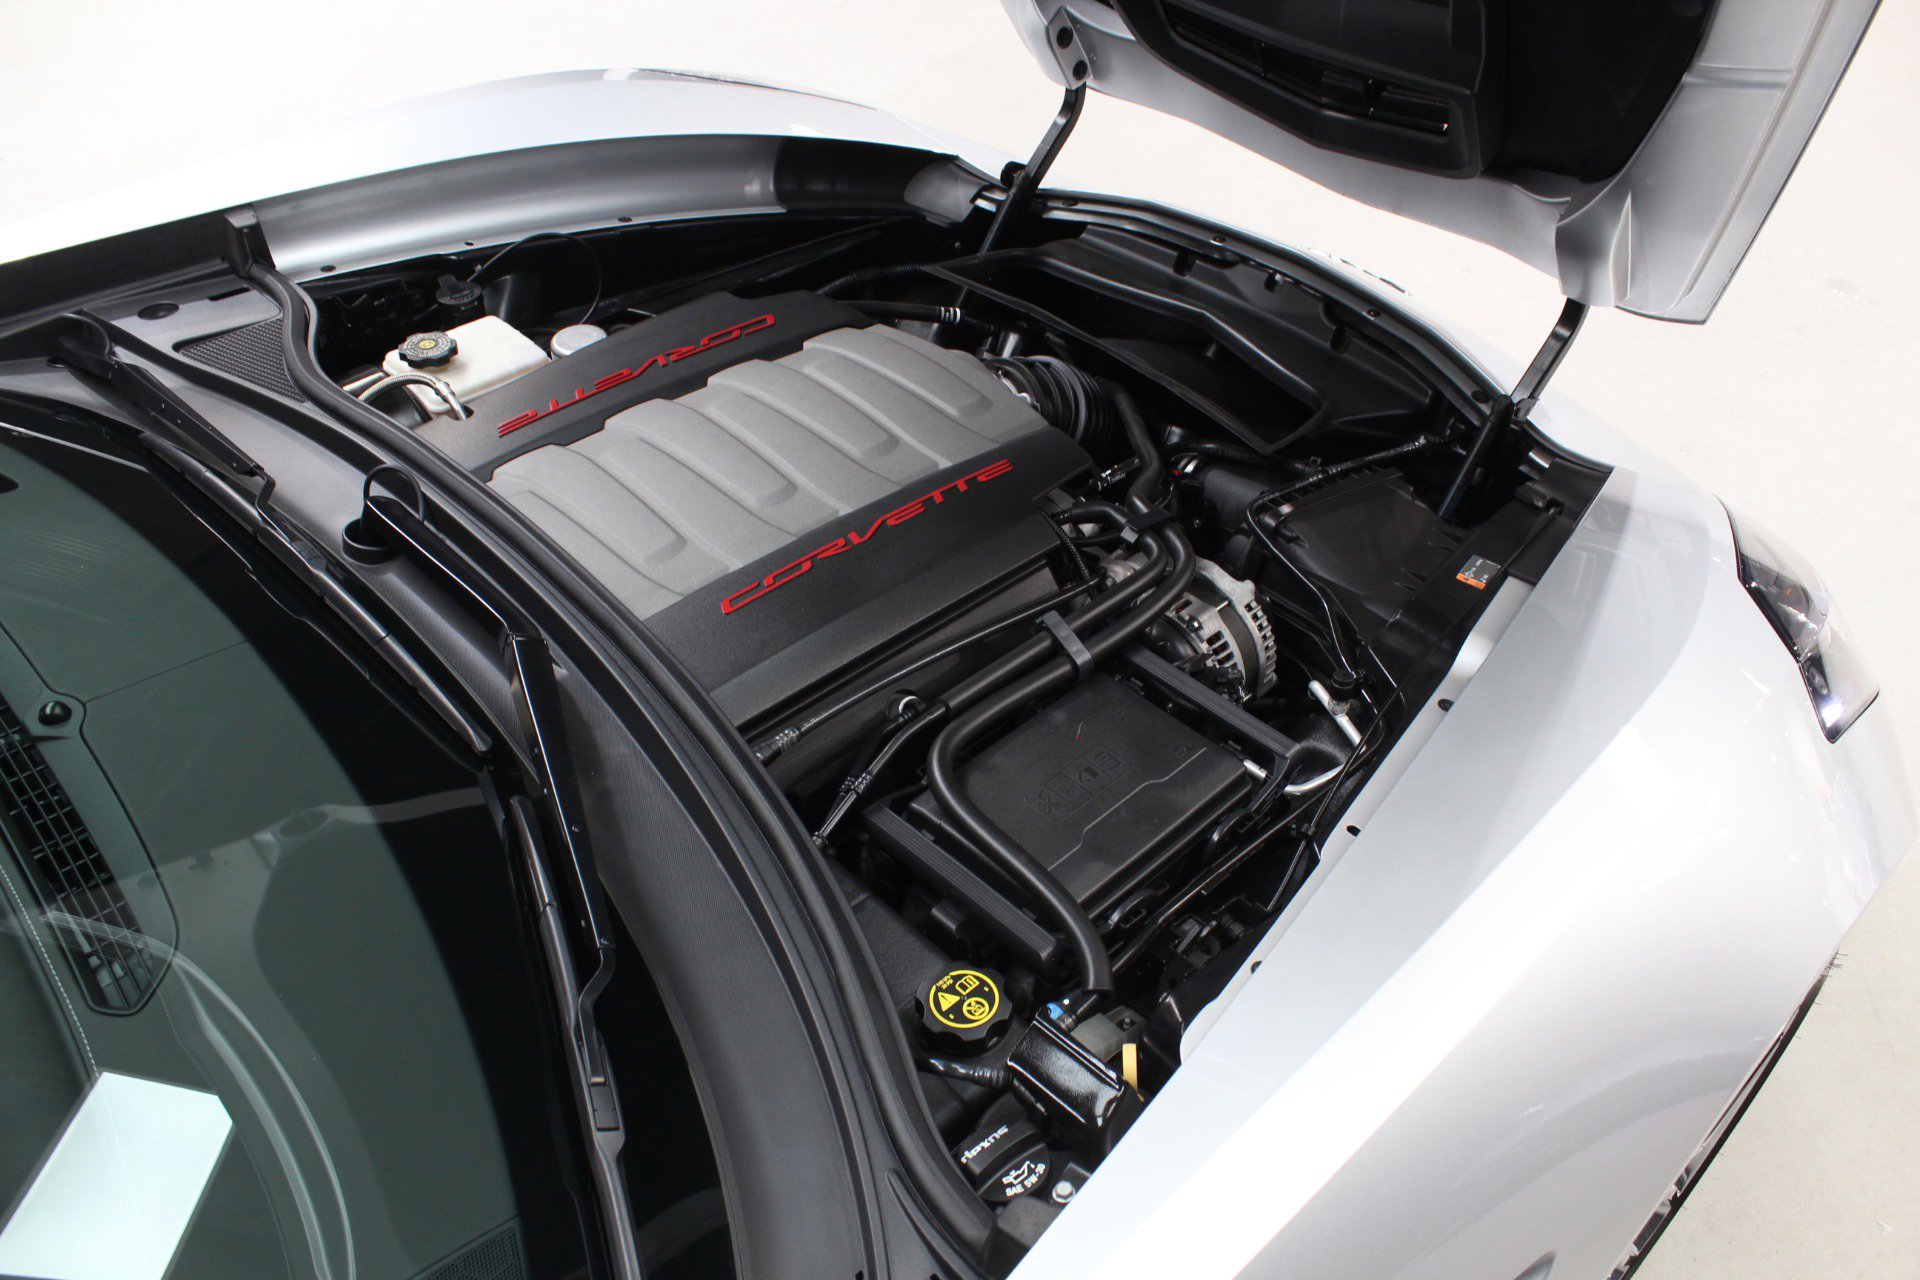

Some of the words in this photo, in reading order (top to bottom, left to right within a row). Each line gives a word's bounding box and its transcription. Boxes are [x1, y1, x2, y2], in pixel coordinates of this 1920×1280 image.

[498, 314, 775, 438] CORVETTE
[721, 458, 1014, 614] CORVETTE
[1005, 1183, 1025, 1197] SAE
